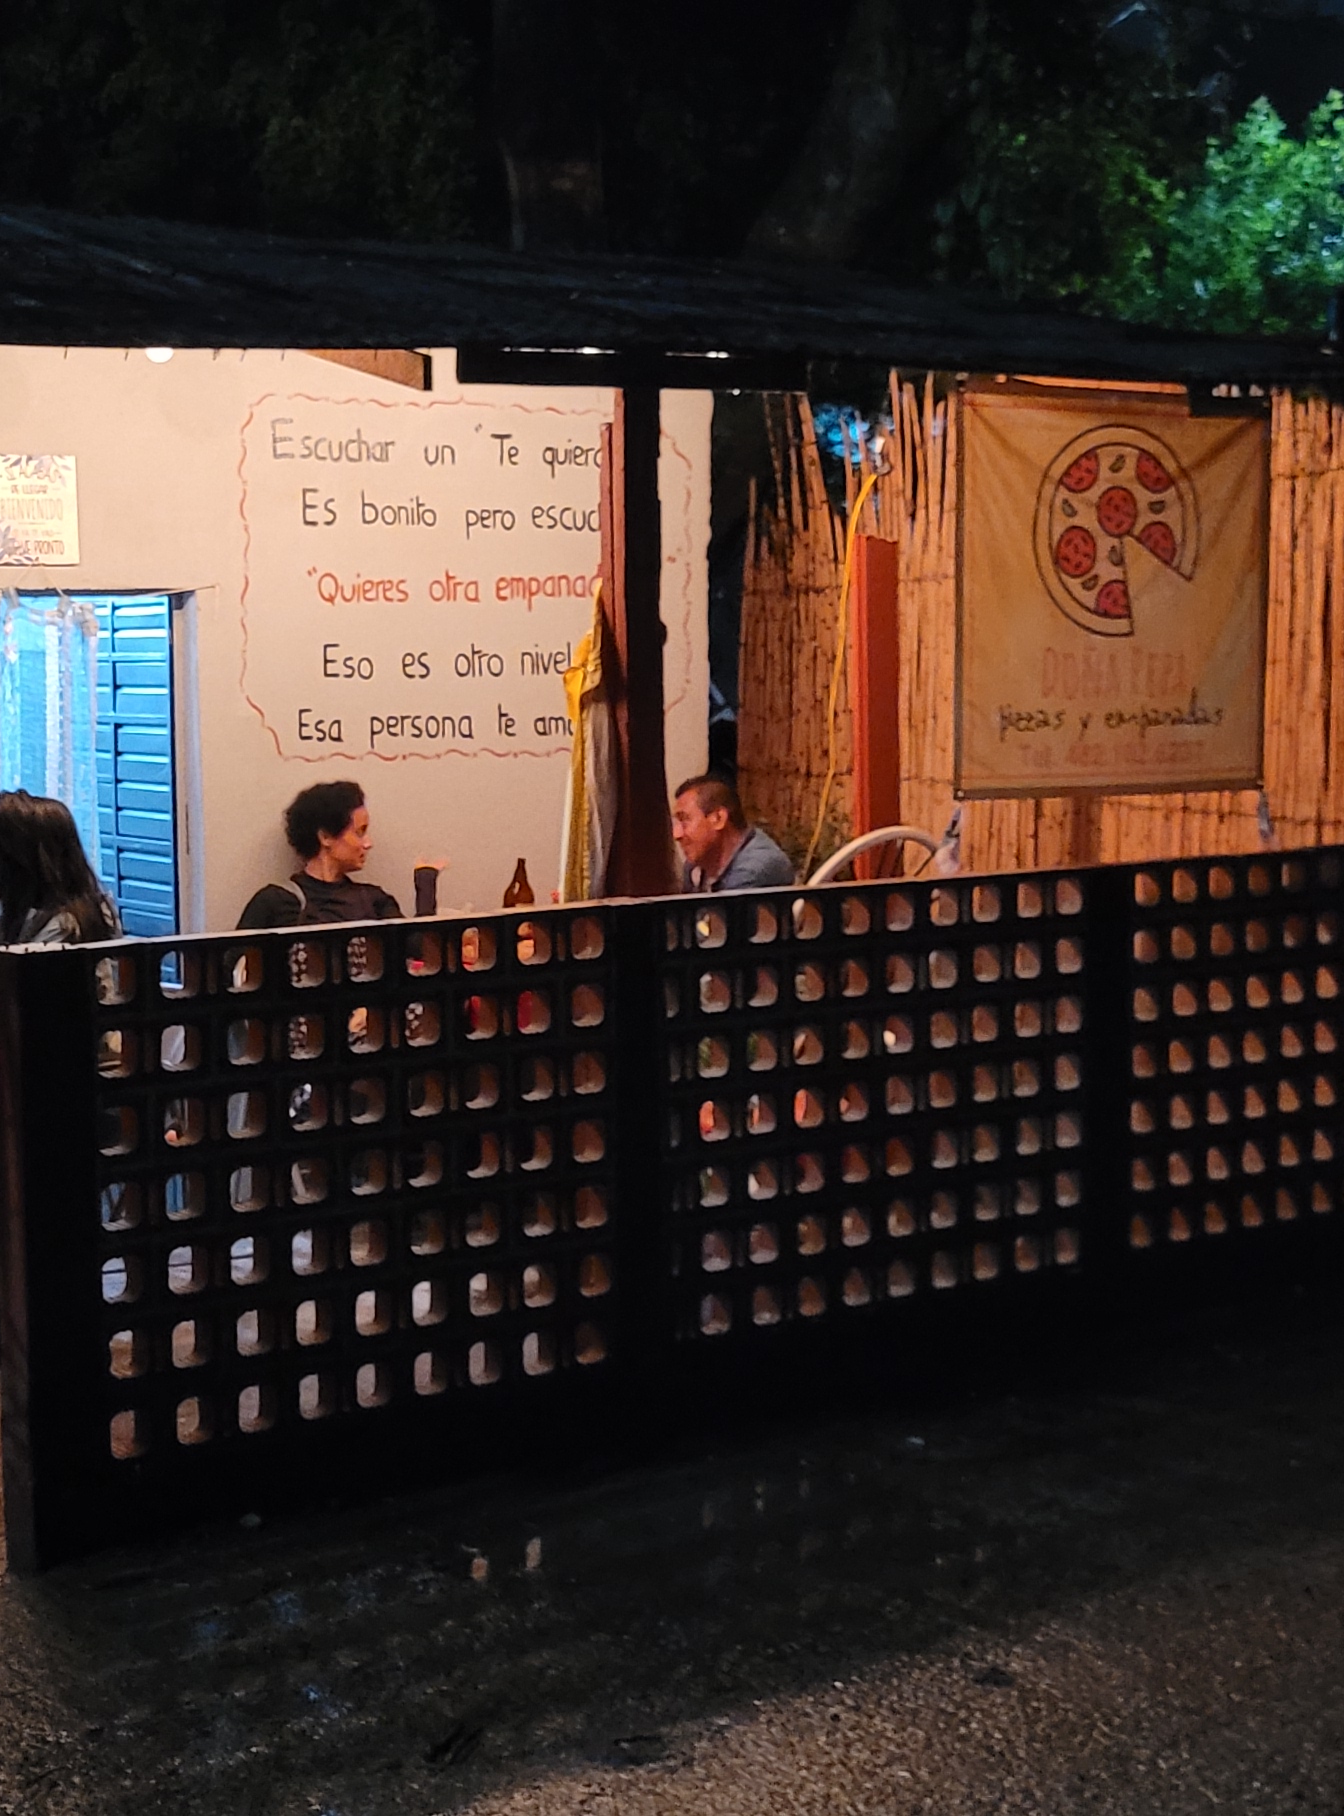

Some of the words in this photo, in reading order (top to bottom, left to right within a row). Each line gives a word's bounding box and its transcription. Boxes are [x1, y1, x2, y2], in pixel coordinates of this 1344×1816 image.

[270, 417, 396, 463] Escuchar
[424, 444, 456, 467] un
[301, 487, 338, 527] Es
[361, 489, 438, 528] bonito
[464, 508, 516, 541] pero
[428, 568, 482, 604] otra
[322, 643, 375, 681] Eso
[402, 651, 431, 680] es
[454, 643, 505, 679] otro
[520, 641, 572, 677] nivel
[297, 708, 344, 743] Esa
[369, 714, 475, 750] persona
[497, 703, 517, 737] te
[1078, 711, 1093, 742] y
[1103, 687, 1224, 739] empanadas
